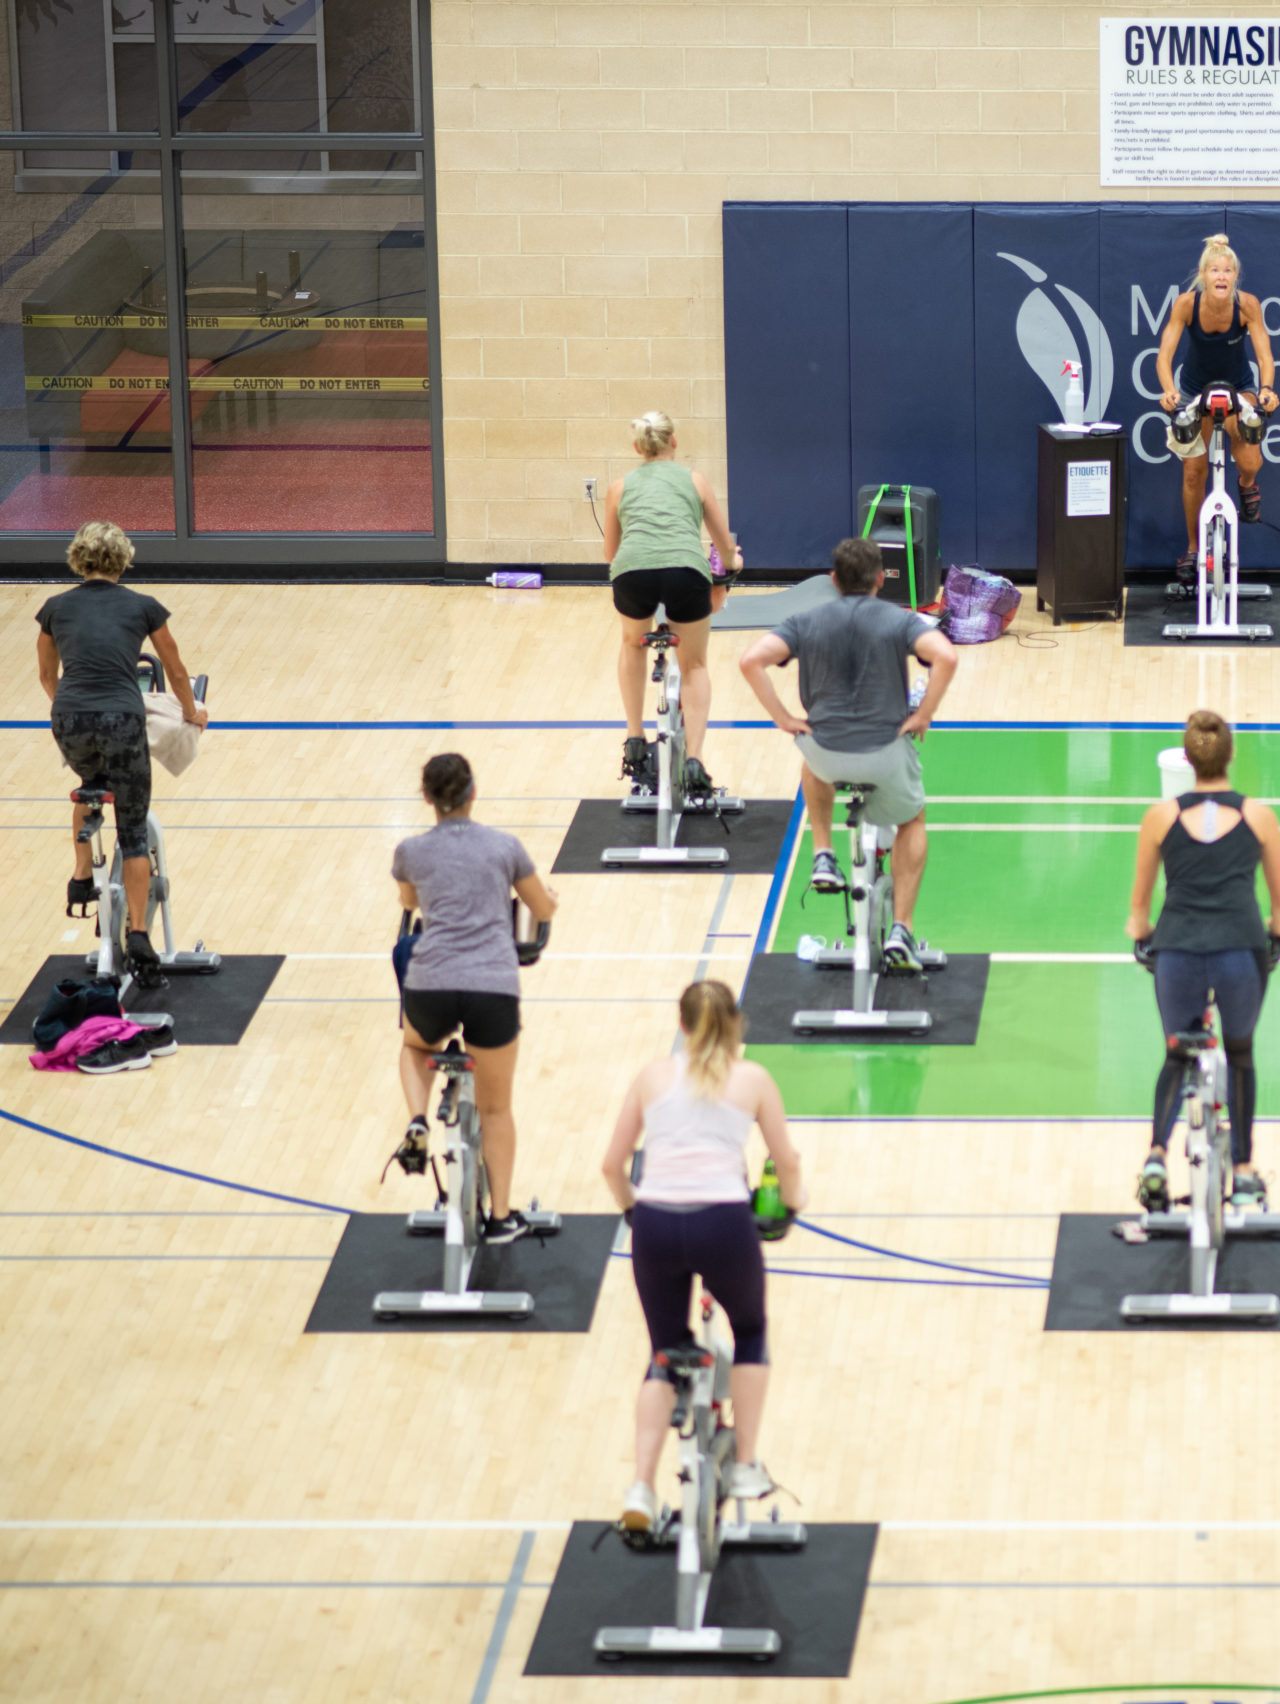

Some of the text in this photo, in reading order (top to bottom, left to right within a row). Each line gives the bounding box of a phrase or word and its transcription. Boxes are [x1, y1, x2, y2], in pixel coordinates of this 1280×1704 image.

[1126, 69, 1177, 85] RULES
[1183, 69, 1196, 85] &
[74, 316, 123, 326] CAUTION
[140, 317, 155, 326] DO
[260, 318, 309, 328] CAUTION
[325, 319, 340, 329] DO
[344, 319, 366, 329] NOT
[370, 319, 404, 329] ENTER
[42, 378, 92, 388] CAUTION
[109, 379, 125, 388] DO
[129, 379, 152, 389] NOT
[233, 379, 283, 389] CAUTION
[300, 380, 315, 390] DO
[319, 380, 341, 390] NOT
[345, 380, 380, 390] ENTER
[1070, 466, 1108, 476] ETIQUETTE
